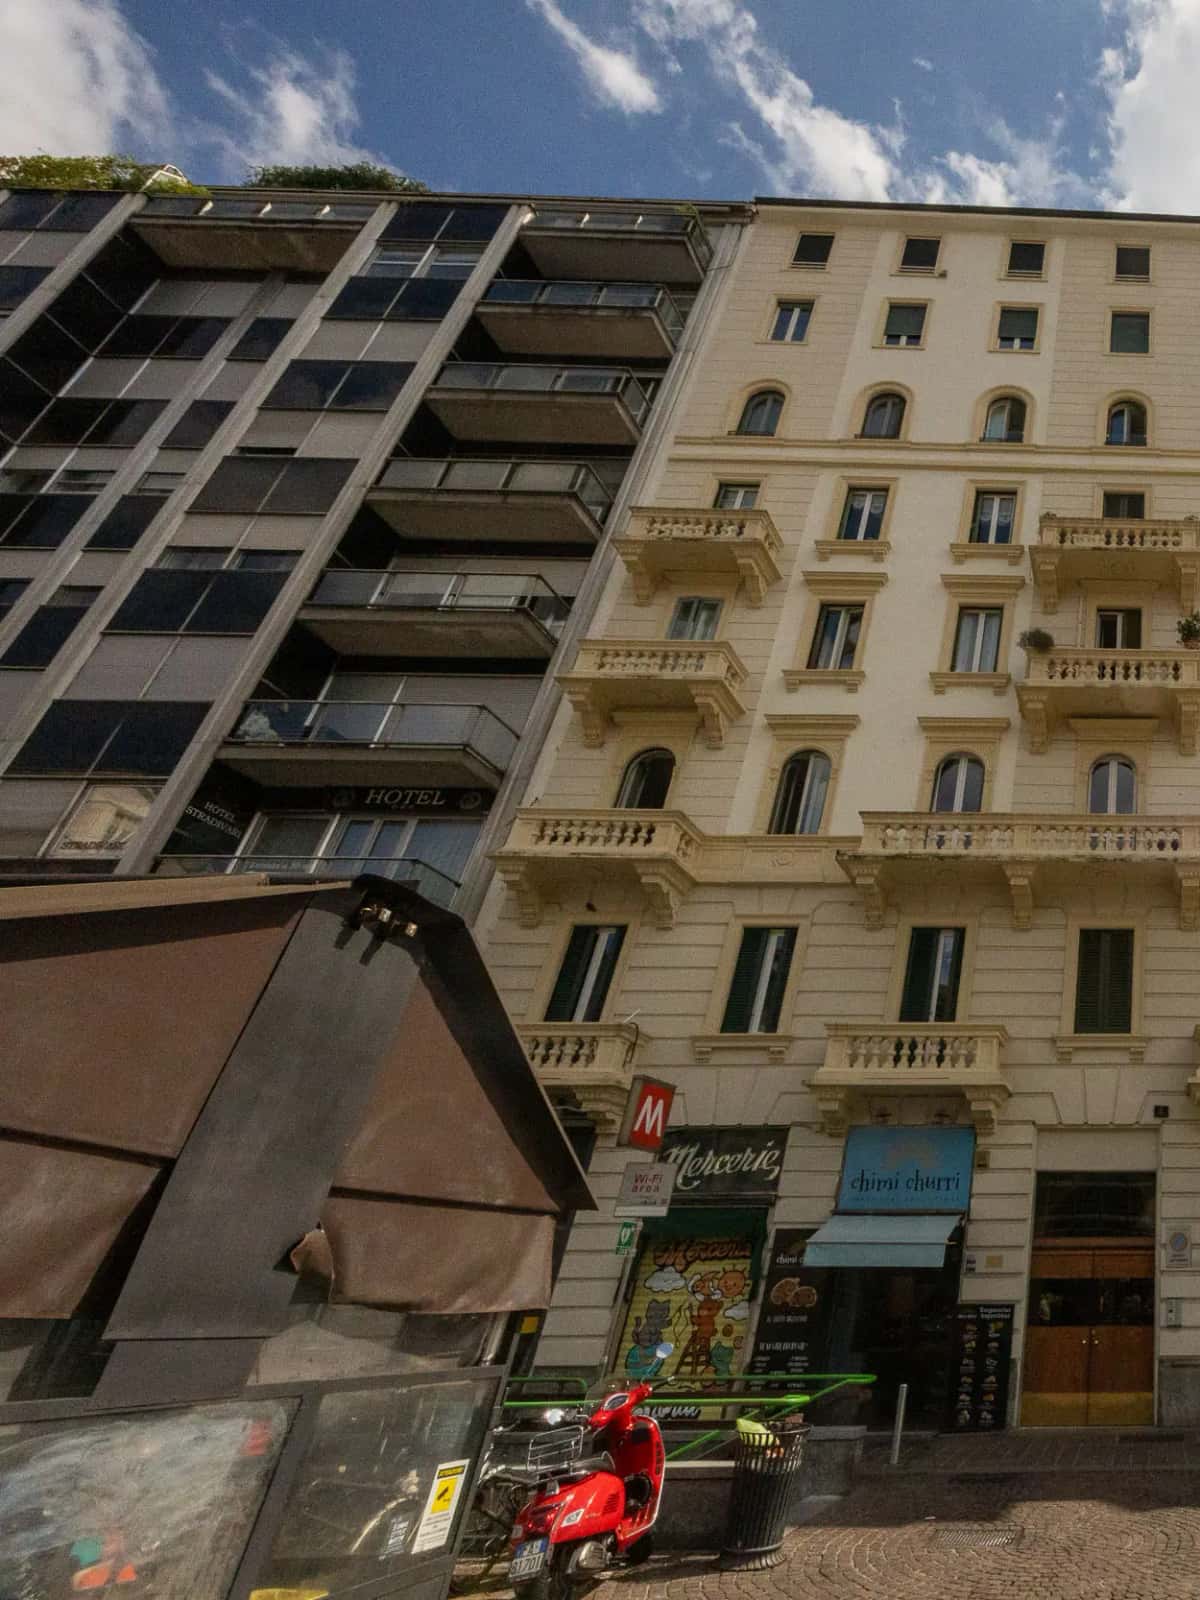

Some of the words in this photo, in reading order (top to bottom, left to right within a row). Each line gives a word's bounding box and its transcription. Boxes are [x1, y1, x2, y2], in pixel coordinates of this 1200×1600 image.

[363, 788, 446, 806] HOTEL
[203, 801, 236, 822] HOTEL
[633, 1095, 664, 1137] M
[850, 1168, 900, 1192] chimi
[906, 1168, 961, 1192] churri
